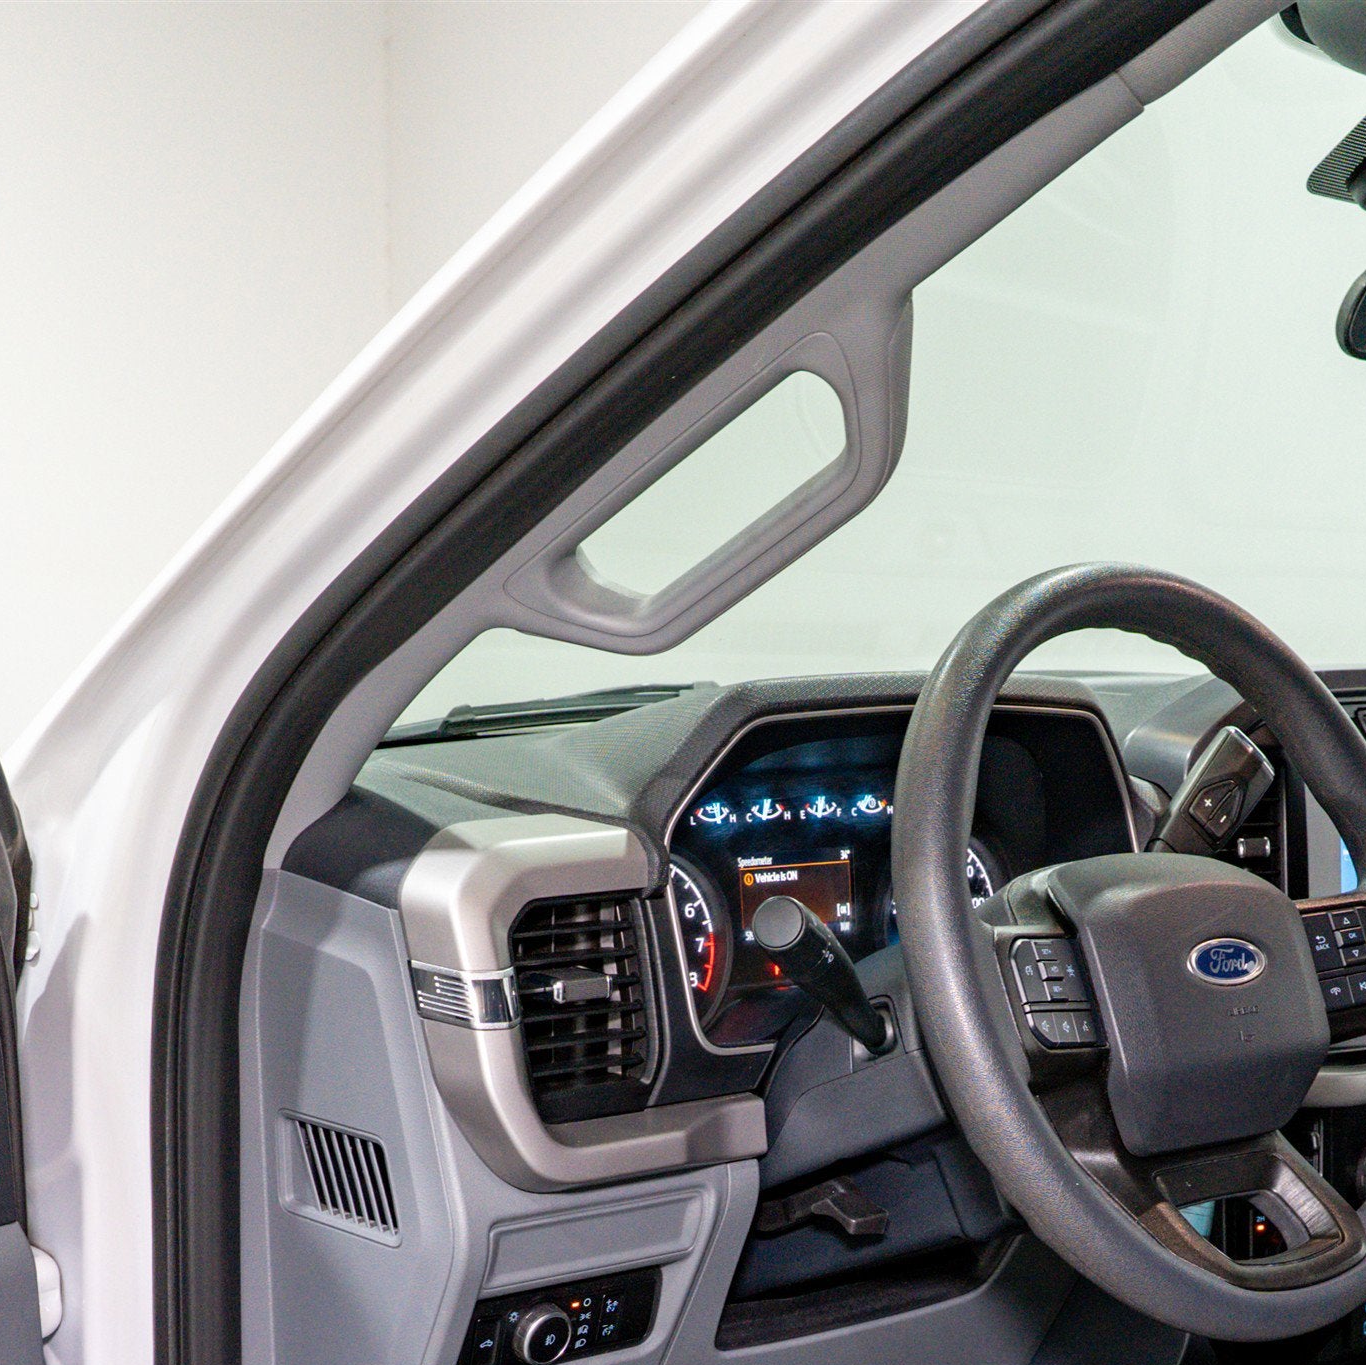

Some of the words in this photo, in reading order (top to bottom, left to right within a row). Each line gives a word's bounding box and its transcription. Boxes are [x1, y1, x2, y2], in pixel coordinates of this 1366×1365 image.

[837, 808, 842, 817] F
[851, 807, 857, 817] C
[887, 805, 893, 814] H
[729, 814, 737, 823] H
[746, 813, 752, 823] C
[784, 811, 791, 820] H
[800, 810, 806, 820] E
[690, 817, 696, 826] L
[737, 856, 773, 869] Speedometer
[754, 872, 780, 883] Vehicle
[786, 870, 798, 881] ON
[684, 902, 695, 919] 6
[695, 937, 705, 953] 7
[1315, 943, 1331, 952] BACK
[1209, 947, 1248, 974] Ford
